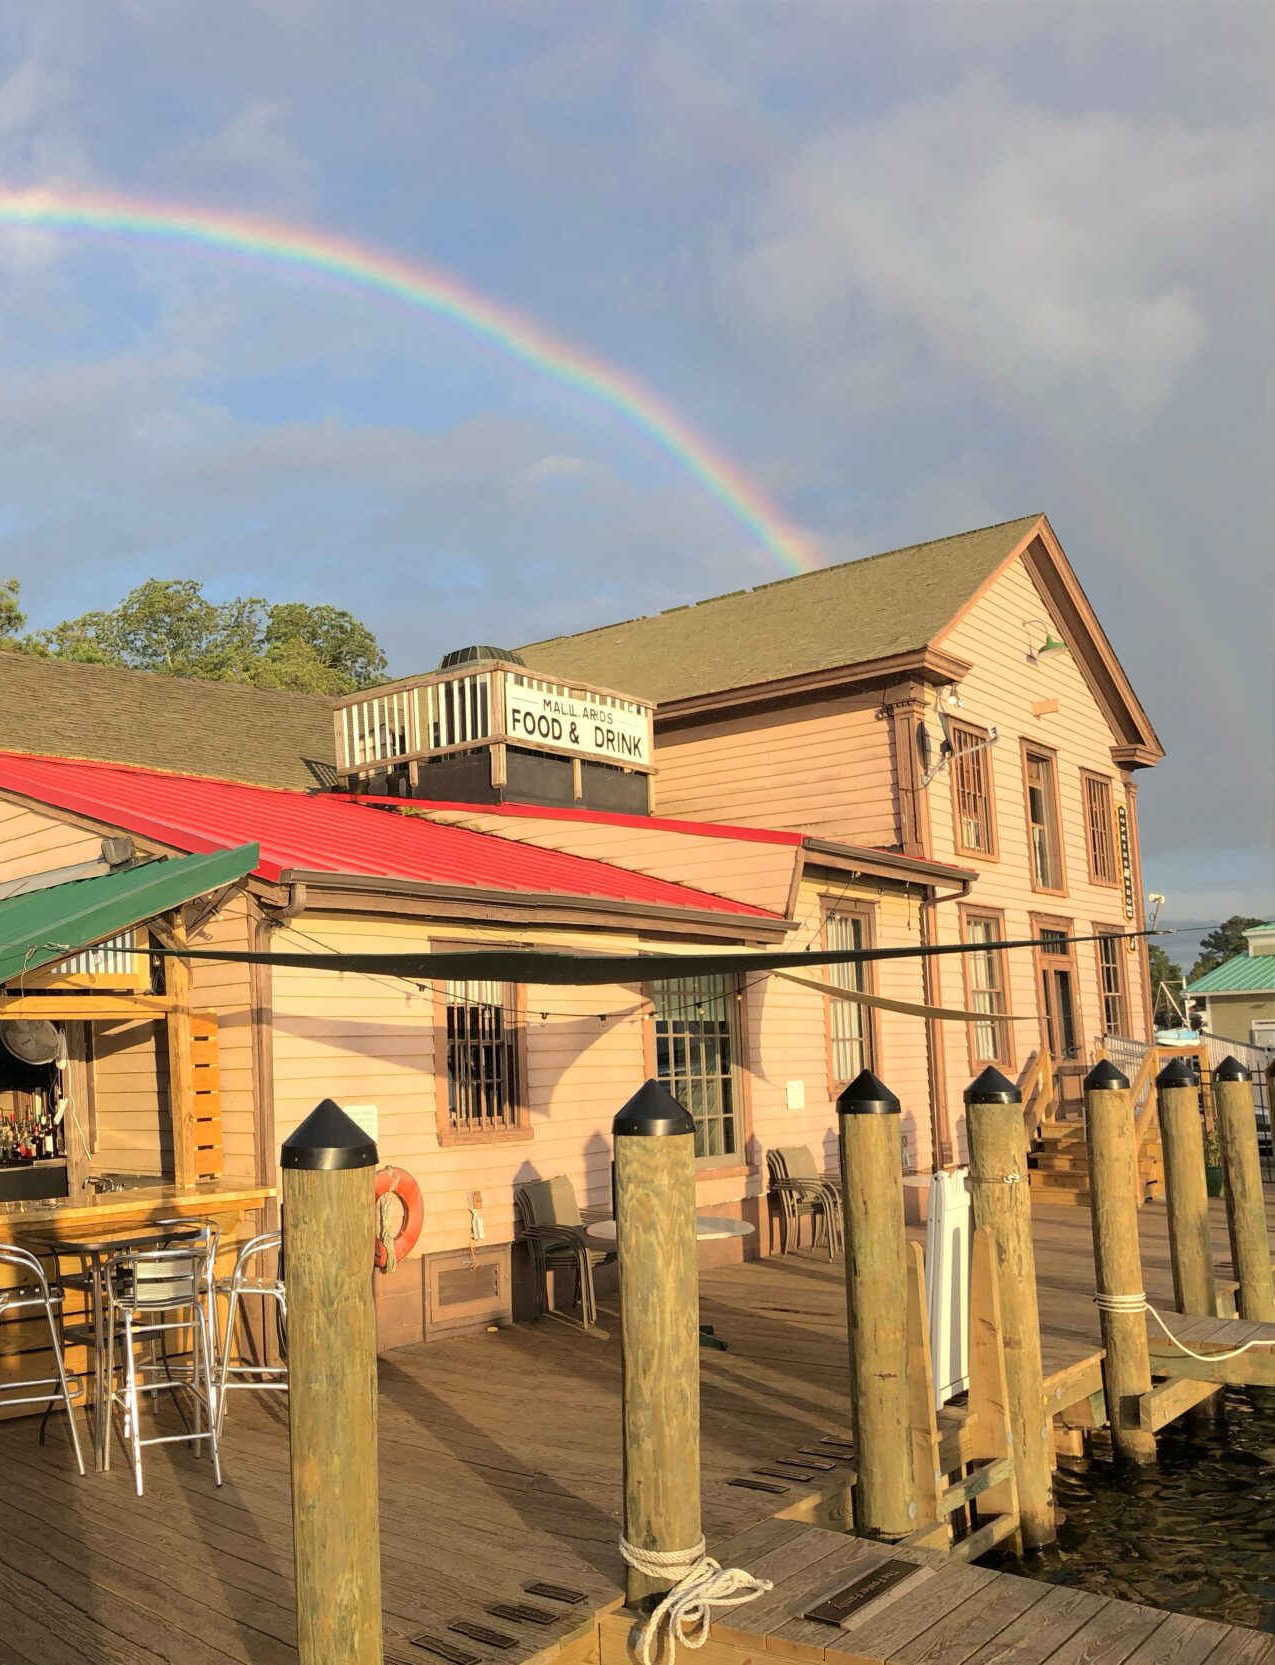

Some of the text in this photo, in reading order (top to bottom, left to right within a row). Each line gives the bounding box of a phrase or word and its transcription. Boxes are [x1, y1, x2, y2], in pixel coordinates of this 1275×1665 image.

[512, 708, 642, 758] FOOD & DRINK
